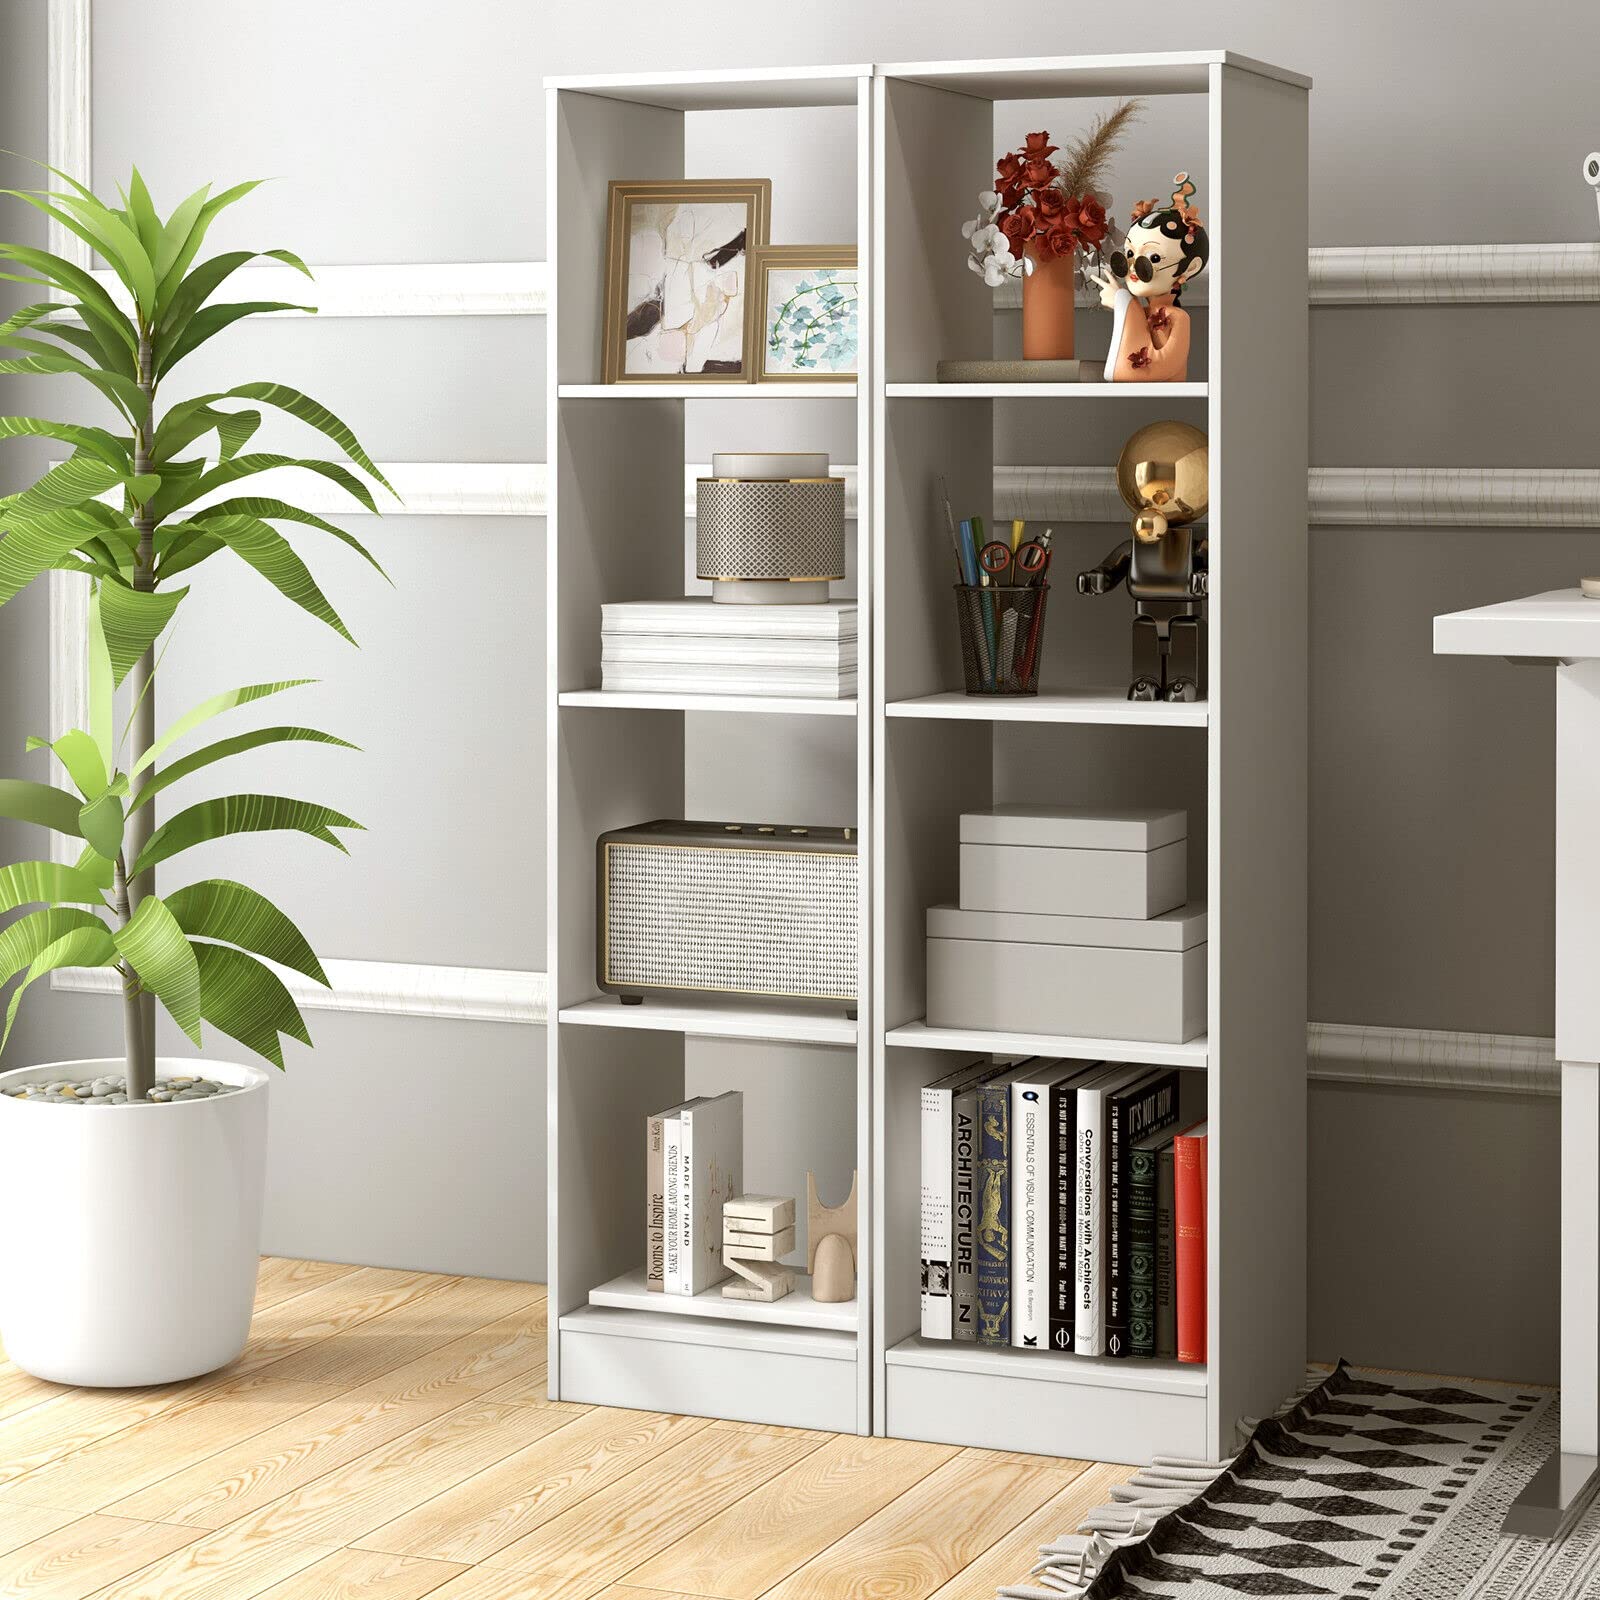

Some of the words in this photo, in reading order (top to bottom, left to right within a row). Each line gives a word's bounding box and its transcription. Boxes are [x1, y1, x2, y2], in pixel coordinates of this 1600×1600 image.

[1058, 1097, 1067, 1108] IT'S
[1129, 1102, 1142, 1135] IT'S
[1142, 1094, 1156, 1128] NOT
[1157, 1086, 1172, 1119] HOW
[1058, 1109, 1067, 1121] NOT
[1111, 1106, 1119, 1117] IT'S
[651, 1120, 663, 1136] Kelly
[1058, 1122, 1067, 1136] HOW
[1111, 1118, 1119, 1130] NOT
[1026, 1112, 1035, 1163] ESSENTIALS
[1058, 1136, 1067, 1152] GOOD
[1111, 1131, 1119, 1144] HOW
[1058, 1153, 1067, 1165] YOU
[1111, 1144, 1119, 1160] GOOD
[668, 1145, 678, 1176] FRIENDS
[1111, 1161, 1119, 1173] YOU
[1026, 1164, 1035, 1177] OF
[1058, 1165, 1067, 1178] ARE,
[1084, 1129, 1093, 1216] Conversations
[668, 1177, 678, 1205] AMONG
[1026, 1178, 1035, 1208] VISUAL
[1058, 1179, 1067, 1191] IT'S
[1111, 1187, 1119, 1199] IT'S
[684, 1194, 690, 1209] BY
[957, 1112, 972, 1275] ARCHITECTURE
[1058, 1192, 1067, 1206] HOW
[648, 1193, 665, 1229] Inspire
[1111, 1200, 1119, 1213] HOW
[668, 1206, 678, 1230] HOME
[650, 1232, 664, 1242] to
[1077, 1218, 1085, 1258] Heinrich
[1084, 1219, 1093, 1245] with
[668, 1230, 678, 1252] YOUR
[1026, 1209, 1035, 1283] COMMUNICATION
[1058, 1236, 1067, 1251] WANT
[1058, 1252, 1067, 1260] TO
[1111, 1243, 1119, 1259] WANT
[648, 1245, 664, 1281] Rooms
[668, 1252, 678, 1274] MAKE
[1111, 1260, 1119, 1268] TO
[1059, 1279, 1067, 1293] Paul
[1083, 1248, 1092, 1310] Architects
[1111, 1286, 1119, 1300] Paul
[1059, 1294, 1067, 1310] Arden
[1111, 1300, 1119, 1317] Arden
